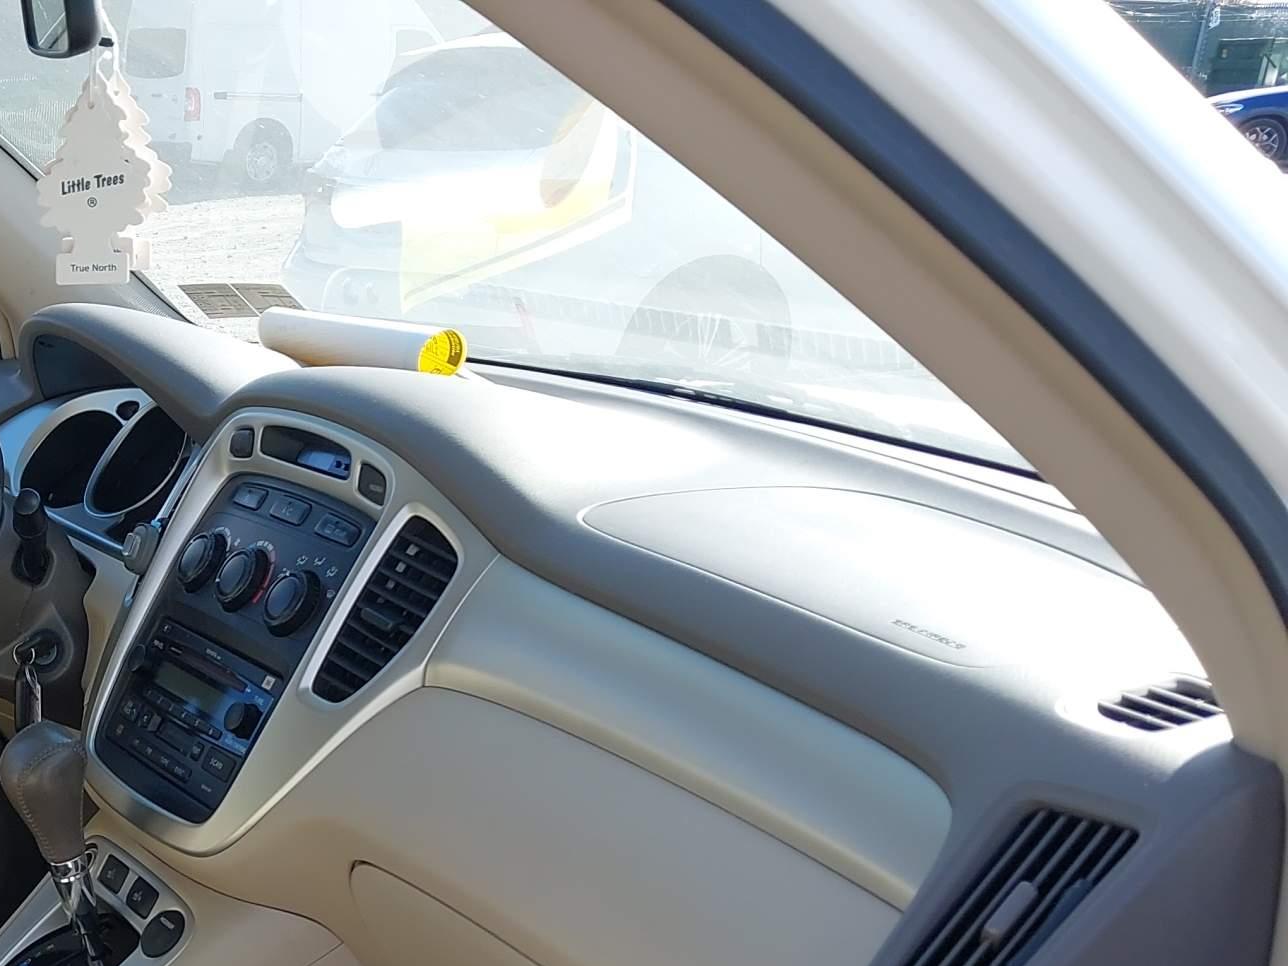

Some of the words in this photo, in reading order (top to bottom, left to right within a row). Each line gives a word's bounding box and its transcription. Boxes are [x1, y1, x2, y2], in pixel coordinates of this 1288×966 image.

[61, 177, 91, 195] Little
[94, 173, 125, 189] Trees
[70, 264, 90, 272] True
[92, 264, 117, 272] North
